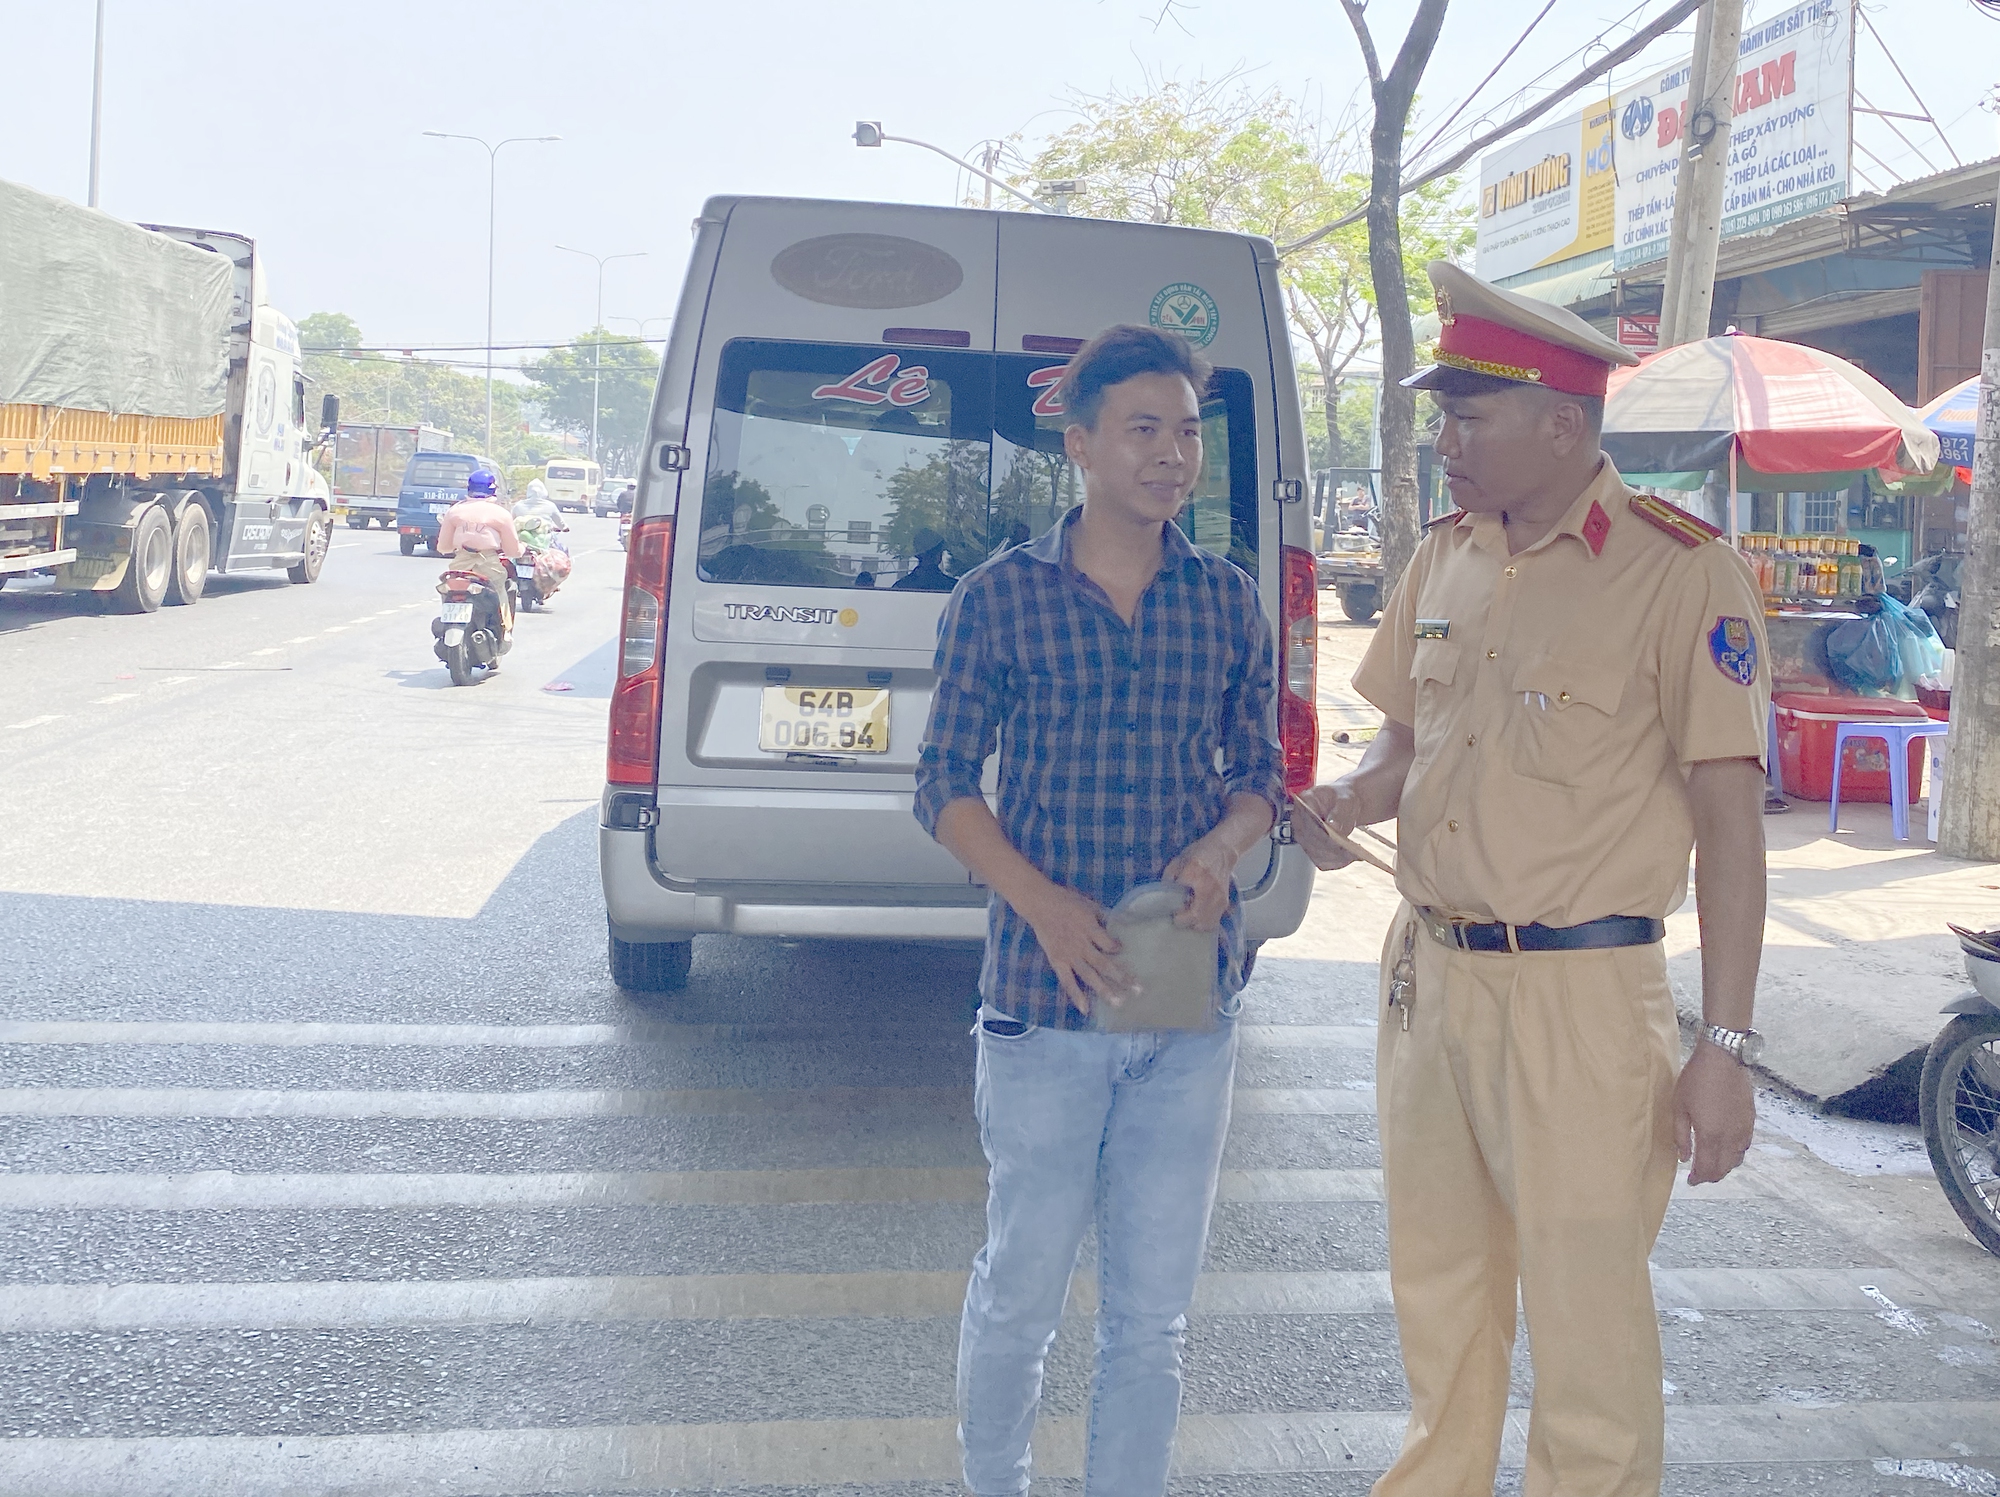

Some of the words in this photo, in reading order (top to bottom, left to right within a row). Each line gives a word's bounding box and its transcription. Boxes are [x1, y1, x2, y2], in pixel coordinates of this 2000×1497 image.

[1740, 30, 1763, 56] HÀNH
[1765, 19, 1786, 43] VIÊN
[1636, 160, 1671, 183] CHUYÊN
[1756, 117, 1779, 138] XÂY
[1780, 103, 1815, 129] DỰNG
[1628, 203, 1645, 222] THÉP
[1646, 196, 1661, 216] TẤM
[1733, 163, 1757, 186] THÉP
[1758, 157, 1769, 178] LÁ
[1771, 150, 1791, 173] CÁC
[1793, 144, 1816, 166] LOẠI
[1636, 222, 1654, 241] CHÍNH
[1655, 216, 1668, 235] XÁC
[1777, 176, 1795, 195] CHO
[1797, 166, 1815, 191] NHÀ
[812, 354, 931, 406] Lê
[1942, 437, 1968, 450] 972
[724, 603, 838, 624] TRANSIT
[799, 691, 853, 717] 64B
